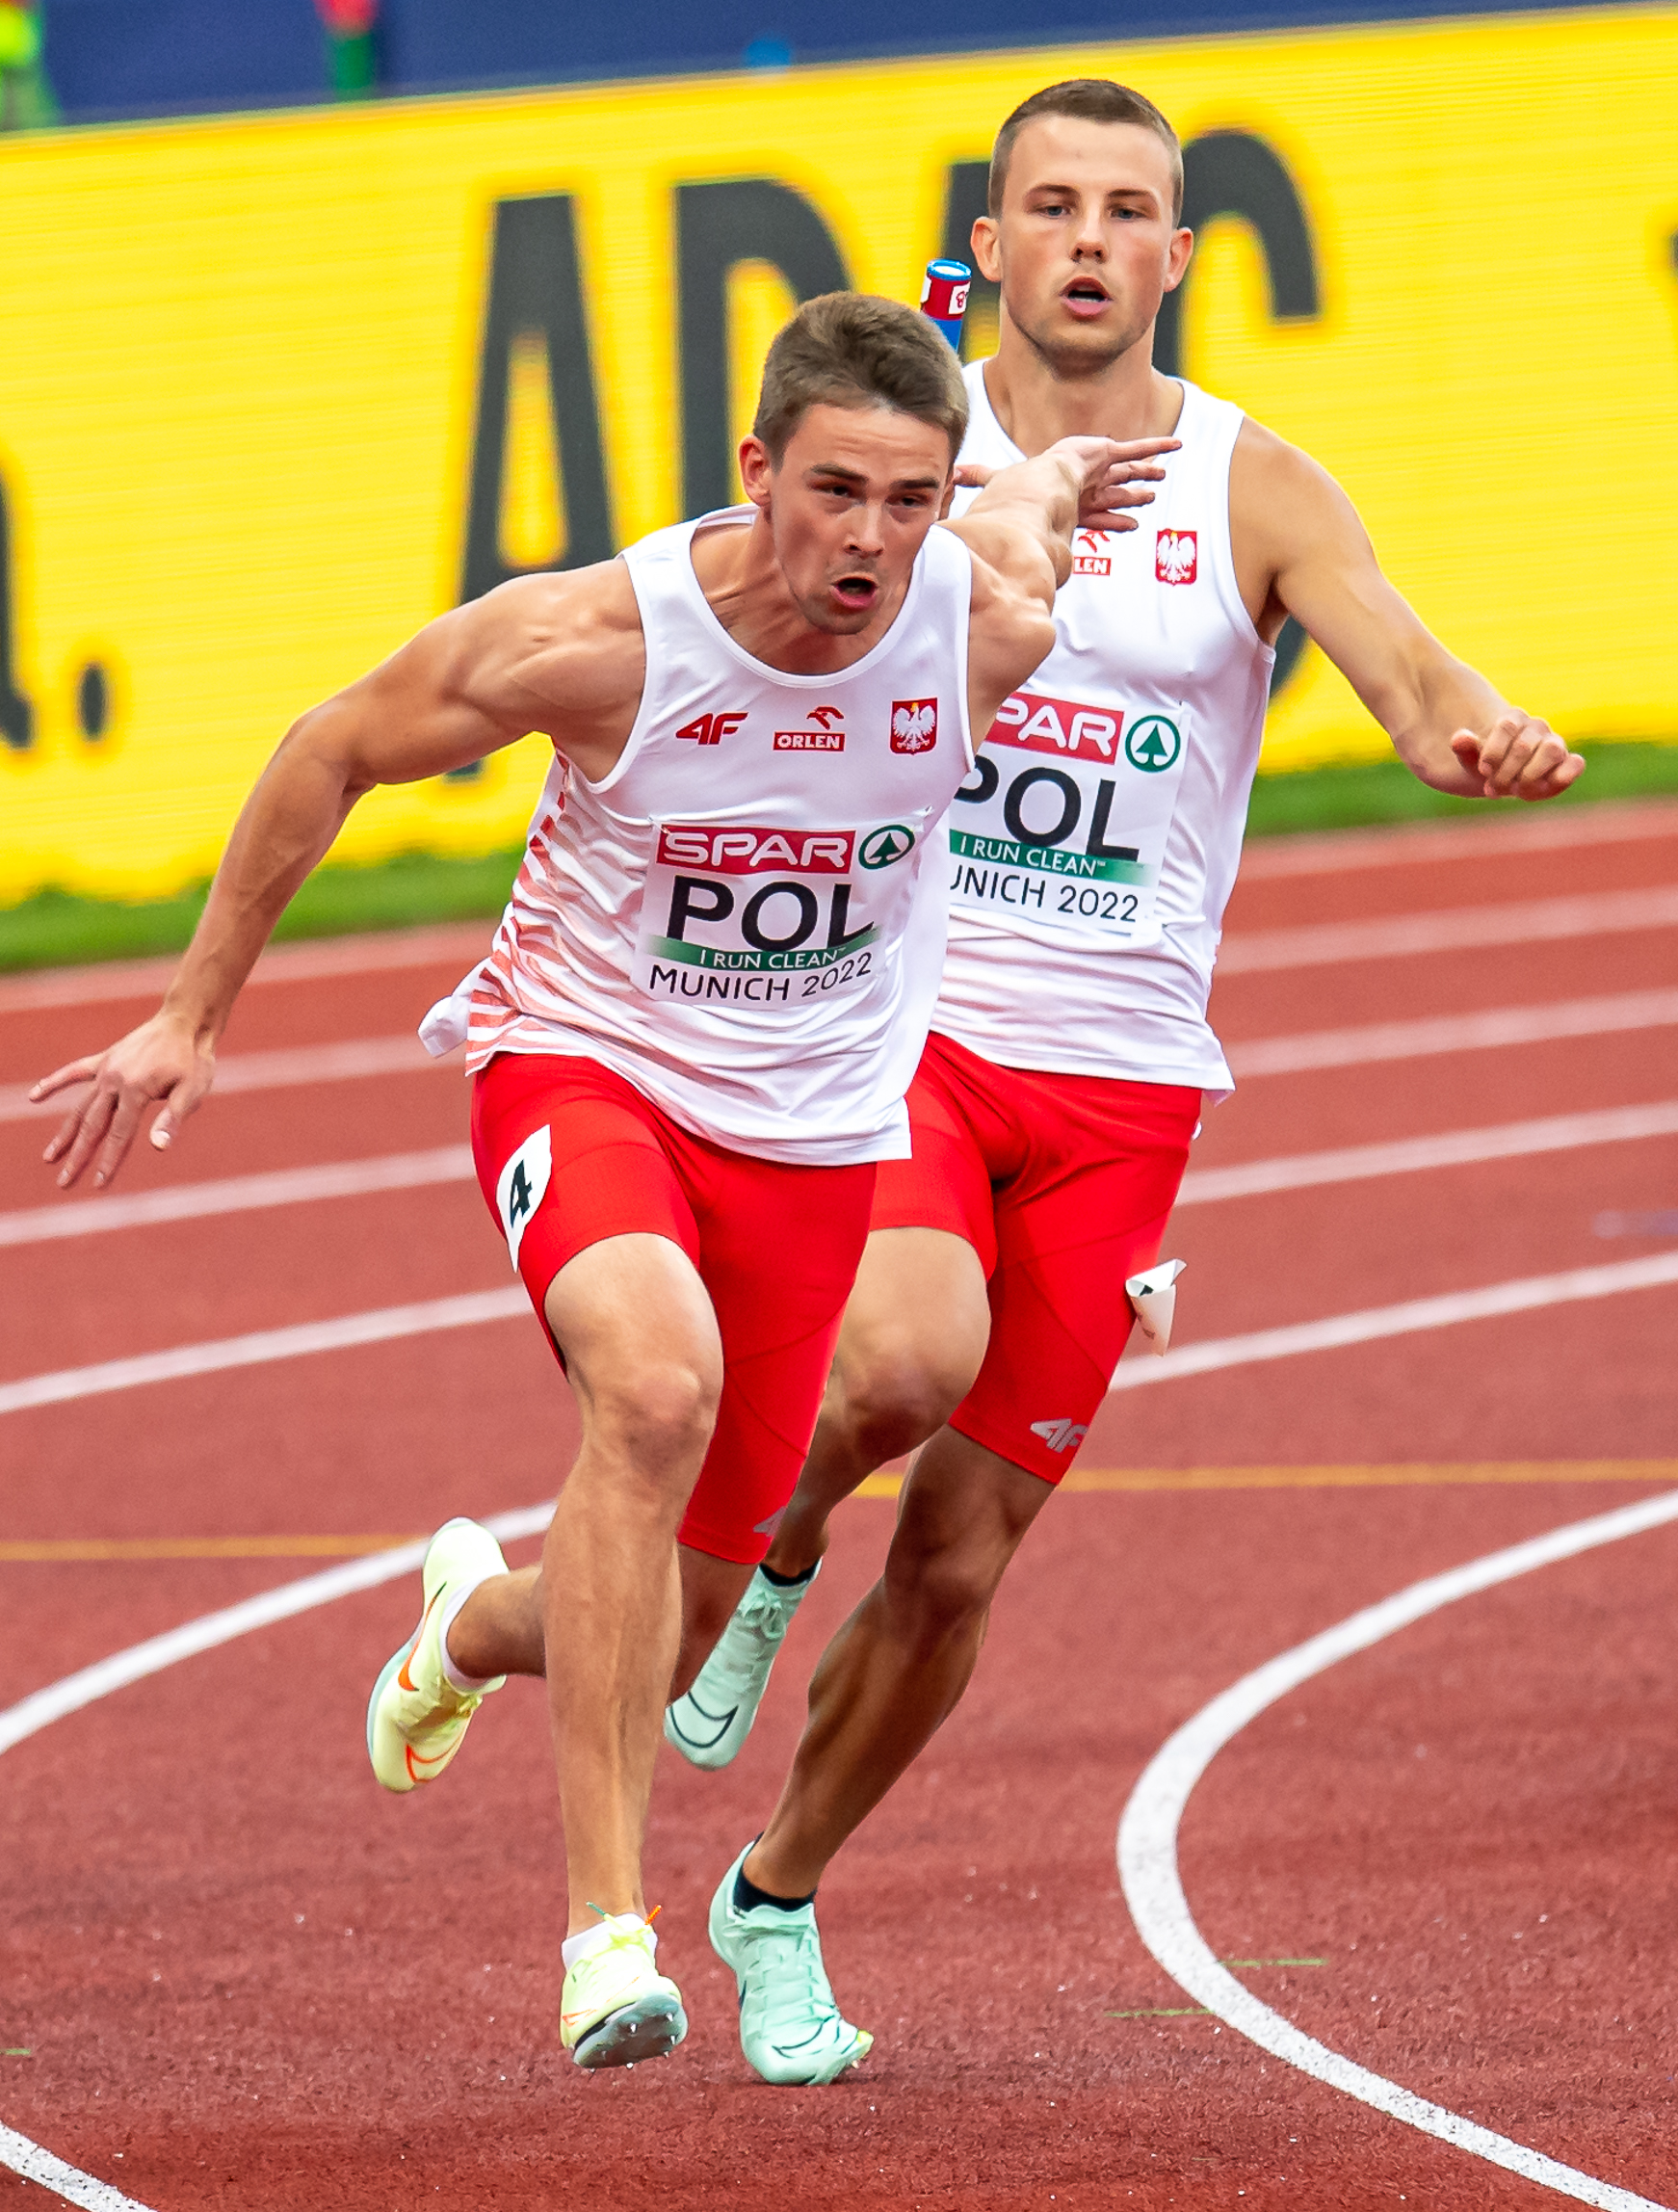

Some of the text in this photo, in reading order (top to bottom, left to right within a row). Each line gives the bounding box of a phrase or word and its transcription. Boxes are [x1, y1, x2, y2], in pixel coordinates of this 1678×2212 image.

[438, 128, 1326, 777] ADC
[1074, 558, 1109, 573] LEN
[675, 712, 749, 746] 4F
[776, 734, 841, 750] ORLEN
[995, 698, 1117, 757] PAR
[664, 831, 849, 868] SPAR
[959, 834, 967, 854] I
[972, 837, 1021, 864] RUN
[666, 874, 875, 953] POL
[949, 864, 1139, 923] UNICH 2022
[648, 952, 873, 1002] MUNICH 2022
[699, 949, 707, 965] I
[713, 952, 762, 969] RUN
[510, 1158, 533, 1229] 4
